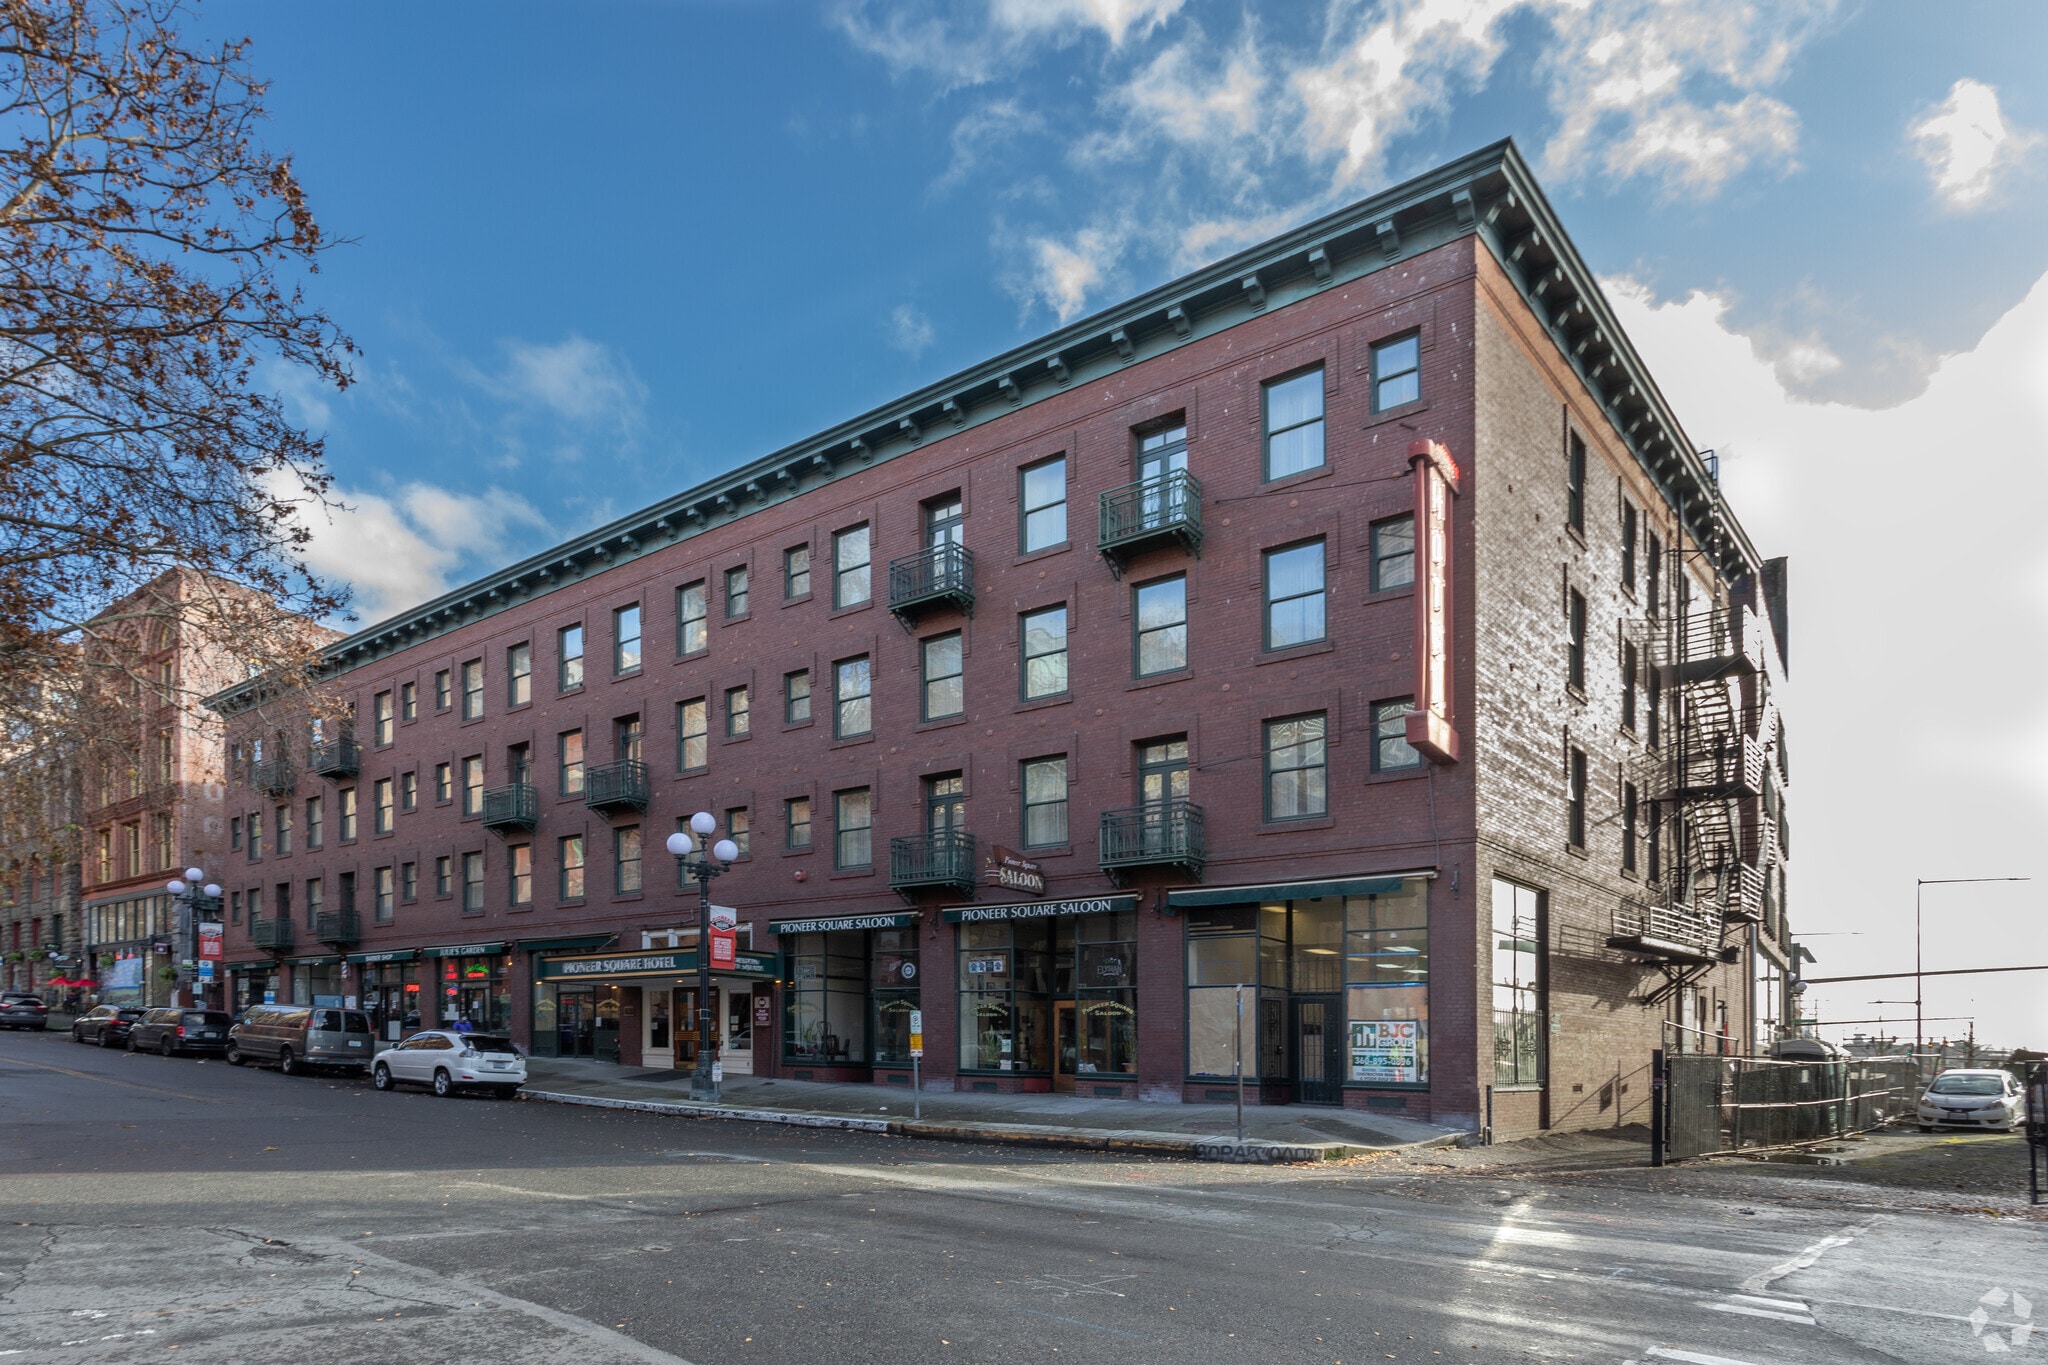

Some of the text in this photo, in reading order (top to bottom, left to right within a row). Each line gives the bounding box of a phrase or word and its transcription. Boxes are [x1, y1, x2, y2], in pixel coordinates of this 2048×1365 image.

[1000, 867, 1043, 889] SALOON
[962, 899, 1111, 921] PIONEER SQUARE SALOON
[780, 916, 895, 933] PIONEER SQUARE SALOON
[461, 946, 485, 955] GARDEN
[562, 955, 677, 974] PIONEER SQUARE HOTEL
[987, 1002, 1009, 1016] SQUARE
[1081, 1000, 1136, 1015] PIONEER SQUARE
[1378, 1023, 1414, 1038] BJC
[1378, 1038, 1414, 1048] GROUP
